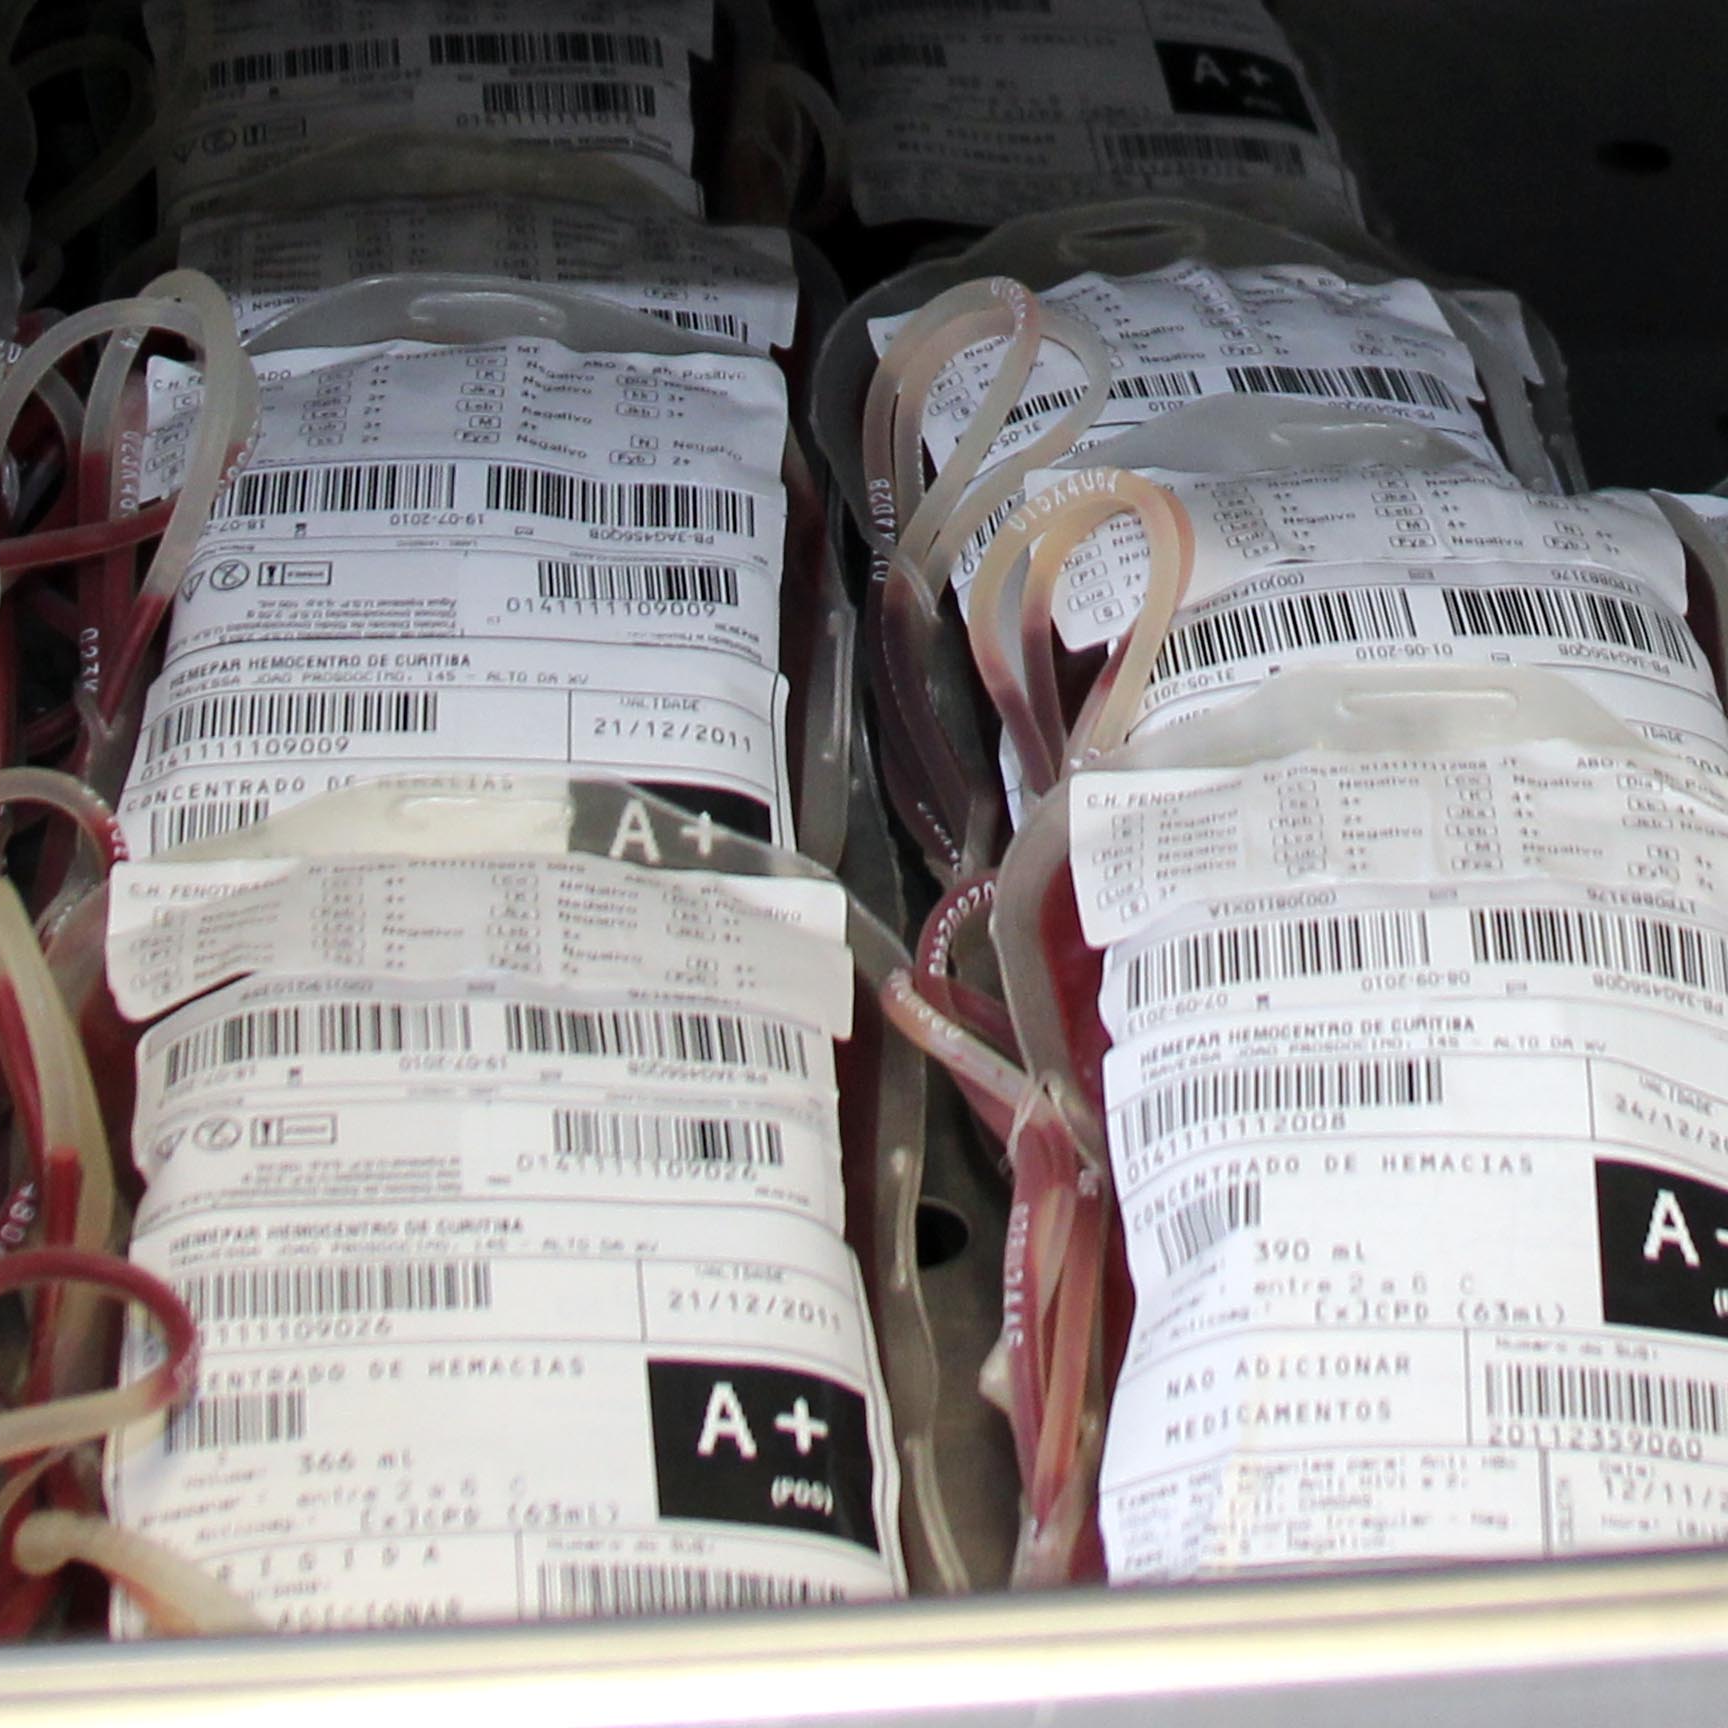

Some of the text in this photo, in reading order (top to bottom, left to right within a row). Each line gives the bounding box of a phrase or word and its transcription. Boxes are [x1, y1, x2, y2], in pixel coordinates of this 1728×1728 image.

[523, 377, 593, 395] Negativo
[683, 370, 747, 381] Positivo
[522, 406, 593, 425] Negativo
[517, 435, 744, 462] Negativo Negativo
[389, 513, 485, 527] 19-07-2010
[1452, 536, 1523, 547] Negativo
[506, 596, 717, 618] 0141111109009
[248, 653, 362, 671] HEMOCENTRO
[368, 653, 389, 668] DE
[394, 652, 471, 669] CURITIBA
[1355, 642, 1453, 661] 01-06-2010
[426, 672, 456, 684] 145
[618, 696, 702, 713] VALIDADE
[593, 716, 754, 753] 21/12/2011
[139, 737, 351, 782] 0141111109009
[1340, 777, 1420, 790] Negativo
[1513, 775, 1593, 789] Negativo
[126, 775, 306, 814] CONCENTRADO
[608, 799, 716, 863] A+
[1360, 970, 1472, 992] 08-09-2010
[1139, 1015, 1476, 1068] HEMEPAR HEMOCENTRO DE CURITIBA
[1127, 1112, 1348, 1186] 0141111112008
[1132, 1153, 1535, 1234] CONCENTRADO DE HEMACIAS
[268, 1220, 398, 1242] HEMOCENTRO
[403, 1220, 428, 1236] DE
[1252, 1238, 1369, 1264] 390 mL
[1252, 1275, 1333, 1296] entre
[667, 1288, 843, 1331] 21/12/2011
[1457, 1298, 1567, 1327] (63mL)
[370, 1356, 587, 1379] DE HEMACIAS
[1165, 1354, 1412, 1402] NAO ADICIONAR
[696, 1381, 828, 1459] A+
[1164, 1398, 1393, 1446] MEDICAMENTOS
[1486, 1423, 1705, 1464] 20112359060
[770, 1475, 835, 1517] (POS)
